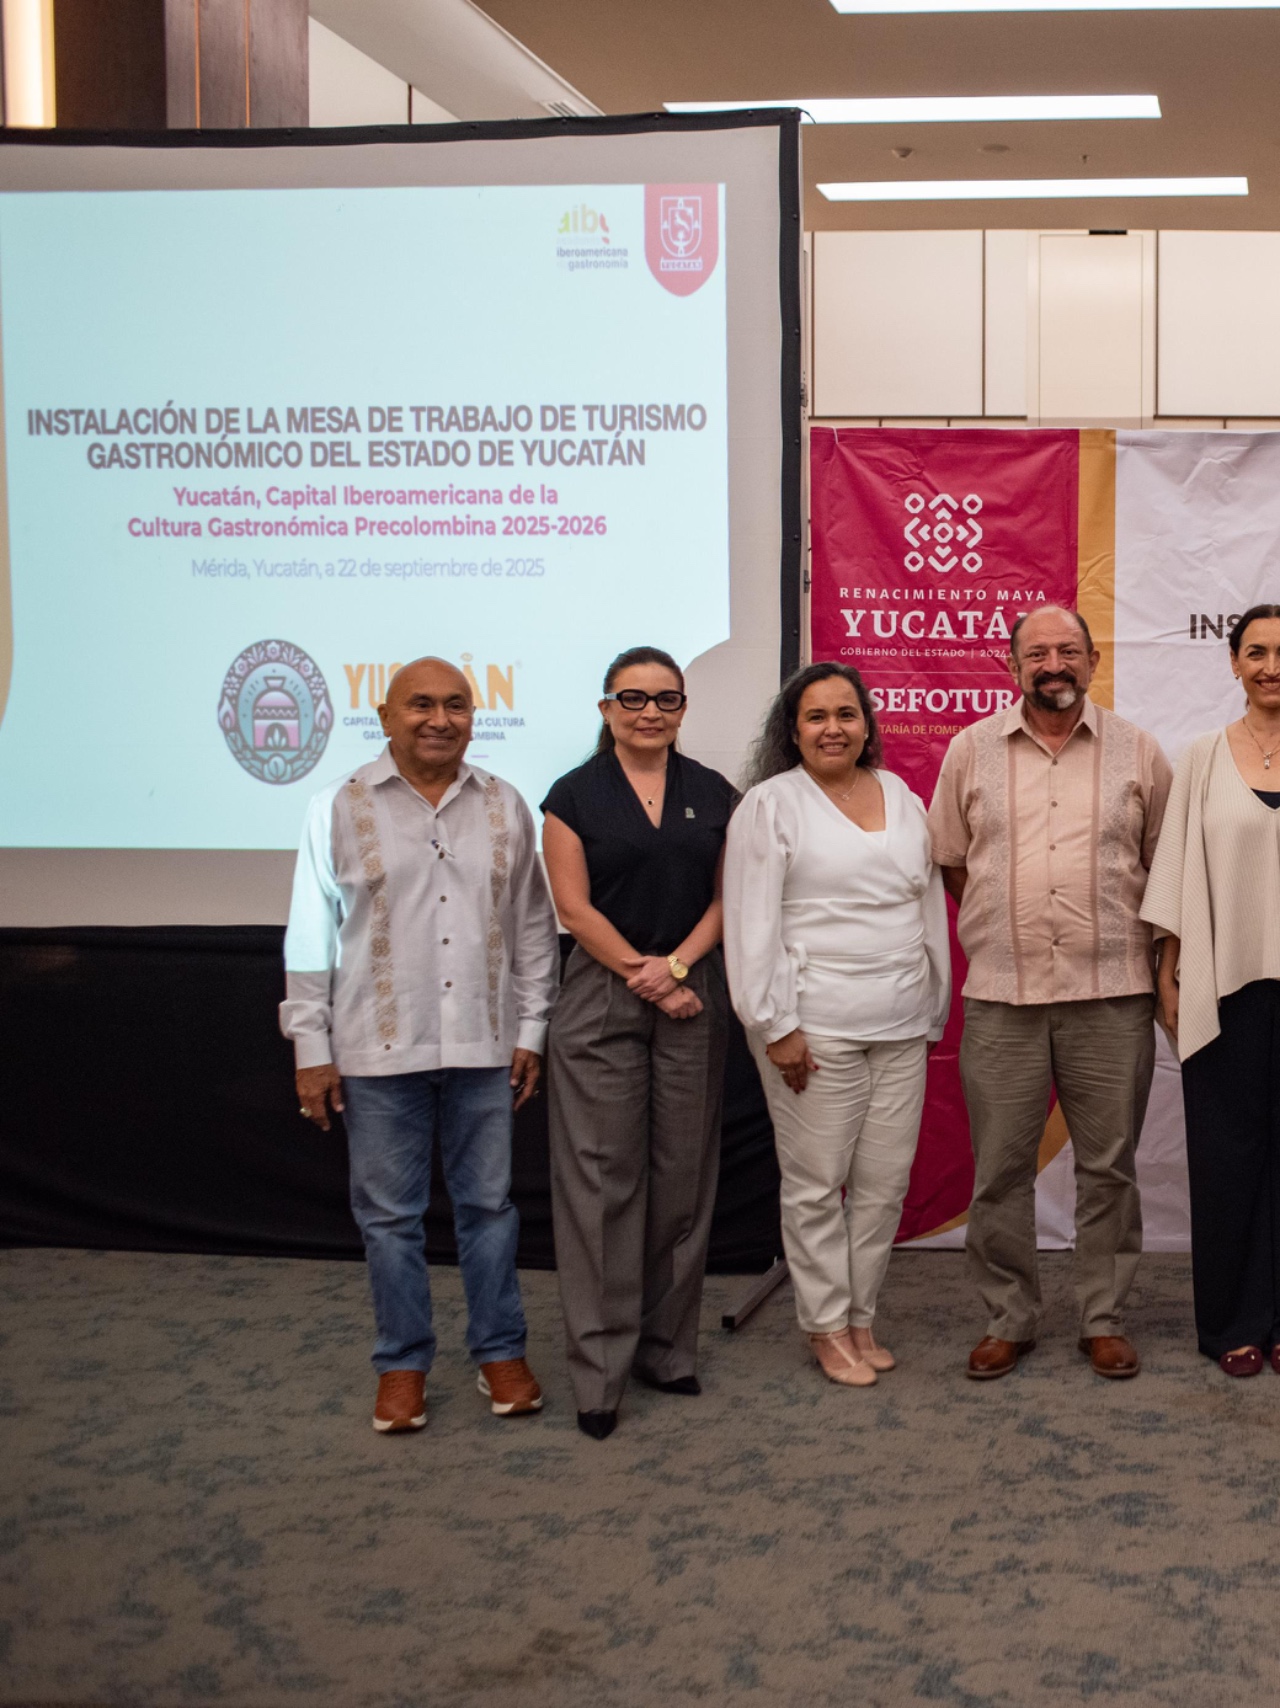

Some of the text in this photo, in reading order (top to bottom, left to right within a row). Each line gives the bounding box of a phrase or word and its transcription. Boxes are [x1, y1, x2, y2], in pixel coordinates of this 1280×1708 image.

[556, 247, 629, 258] iberoamericana
[568, 259, 629, 271] gastronomía
[27, 400, 708, 436] INSTALACIÓN DE LA MESA DE TRABAJO DE TURISMO
[87, 431, 646, 470] GASTRONÓMICO DEL ESTADO DE YUCATÁN
[173, 483, 559, 510] Yucatán, Capital Iberoamericana de la
[127, 514, 607, 537] Cultura Gastronómica Precolombina 2025-2026
[191, 557, 546, 580] Mérida, Yucatán, a 22 de septiembre de 2025
[839, 587, 1047, 602] RENACIMIENTO MAYA
[840, 606, 1028, 640] YUCATÁ
[840, 647, 898, 657] GOBIERNO
[901, 648, 922, 657] DEL
[925, 648, 966, 658] ESTADO
[869, 688, 1015, 713] SEFOTUR
[485, 717, 525, 727] CULTURA
[879, 722, 911, 735] TARÍA
[912, 724, 927, 735] DE
